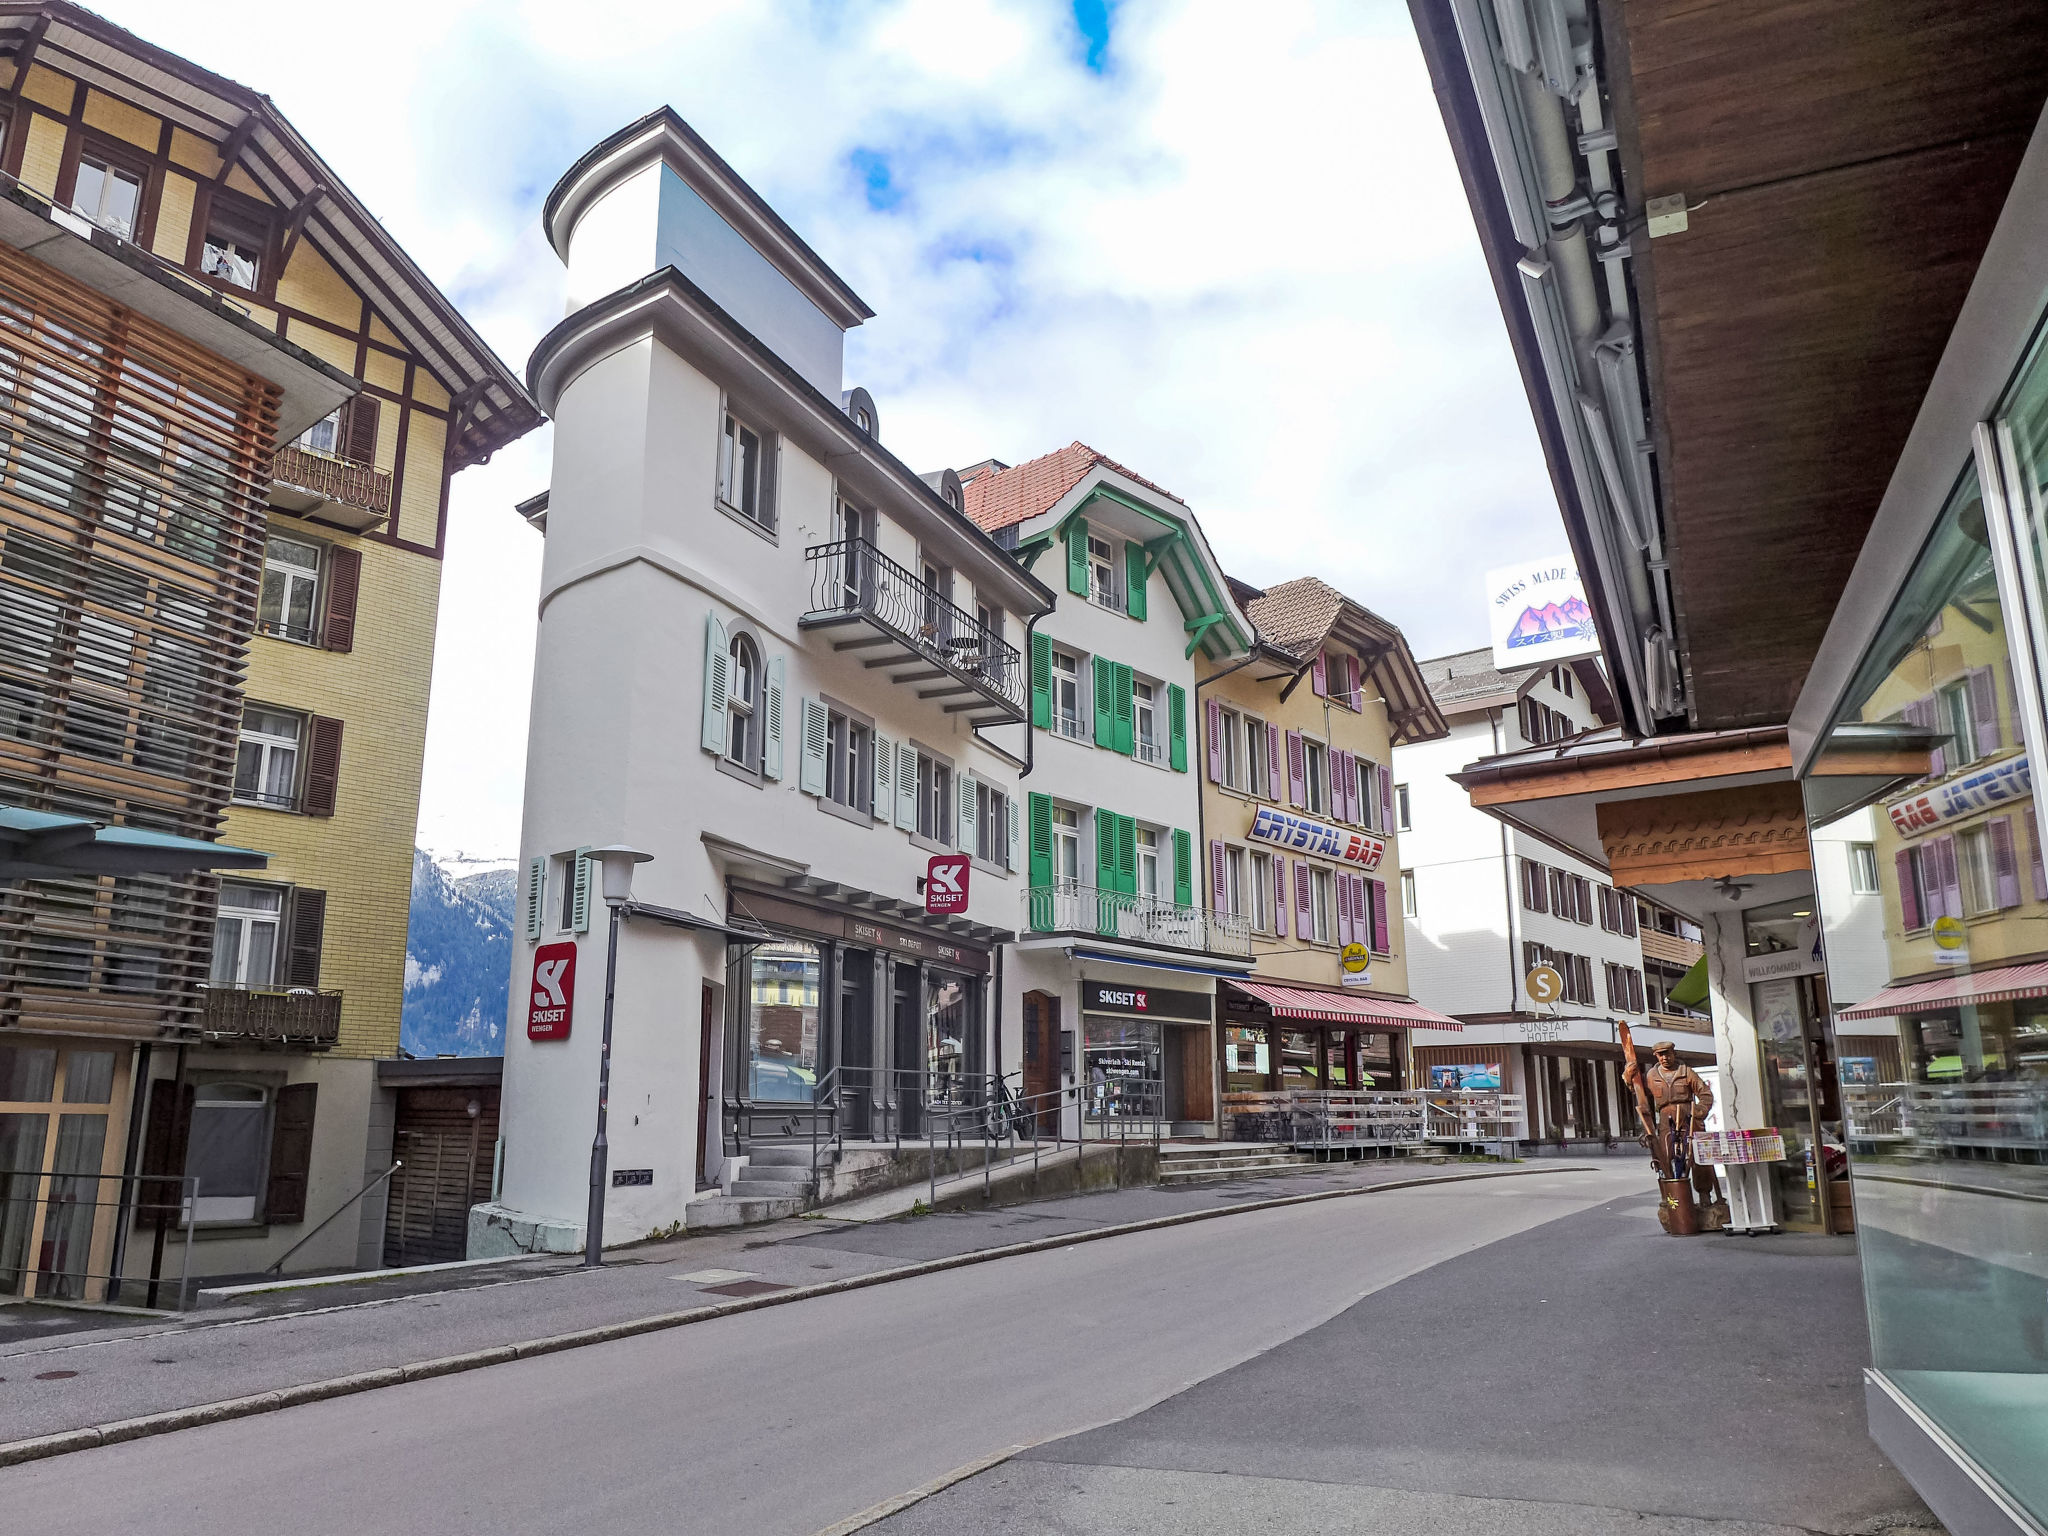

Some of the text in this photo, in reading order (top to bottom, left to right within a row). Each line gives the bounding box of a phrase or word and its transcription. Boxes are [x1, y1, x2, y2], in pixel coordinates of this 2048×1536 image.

[1495, 579, 1527, 608] SWISS
[1532, 567, 1567, 584] MADE
[1252, 810, 1383, 867] CRYSTAL BAR
[930, 894, 963, 902] SKISET
[854, 924, 876, 938] SKISET
[938, 945, 955, 957] SKISET
[1748, 961, 1802, 977] WILLKOMMEN
[1099, 990, 1135, 1006] SKISET
[532, 1009, 566, 1023] SKISET
[1519, 1021, 1569, 1032] SUNSTAR
[1527, 1031, 1562, 1042] HOTEL
[1098, 1058, 1121, 1066] Skiverleih
[1106, 1068, 1139, 1076] skiwengen.com
